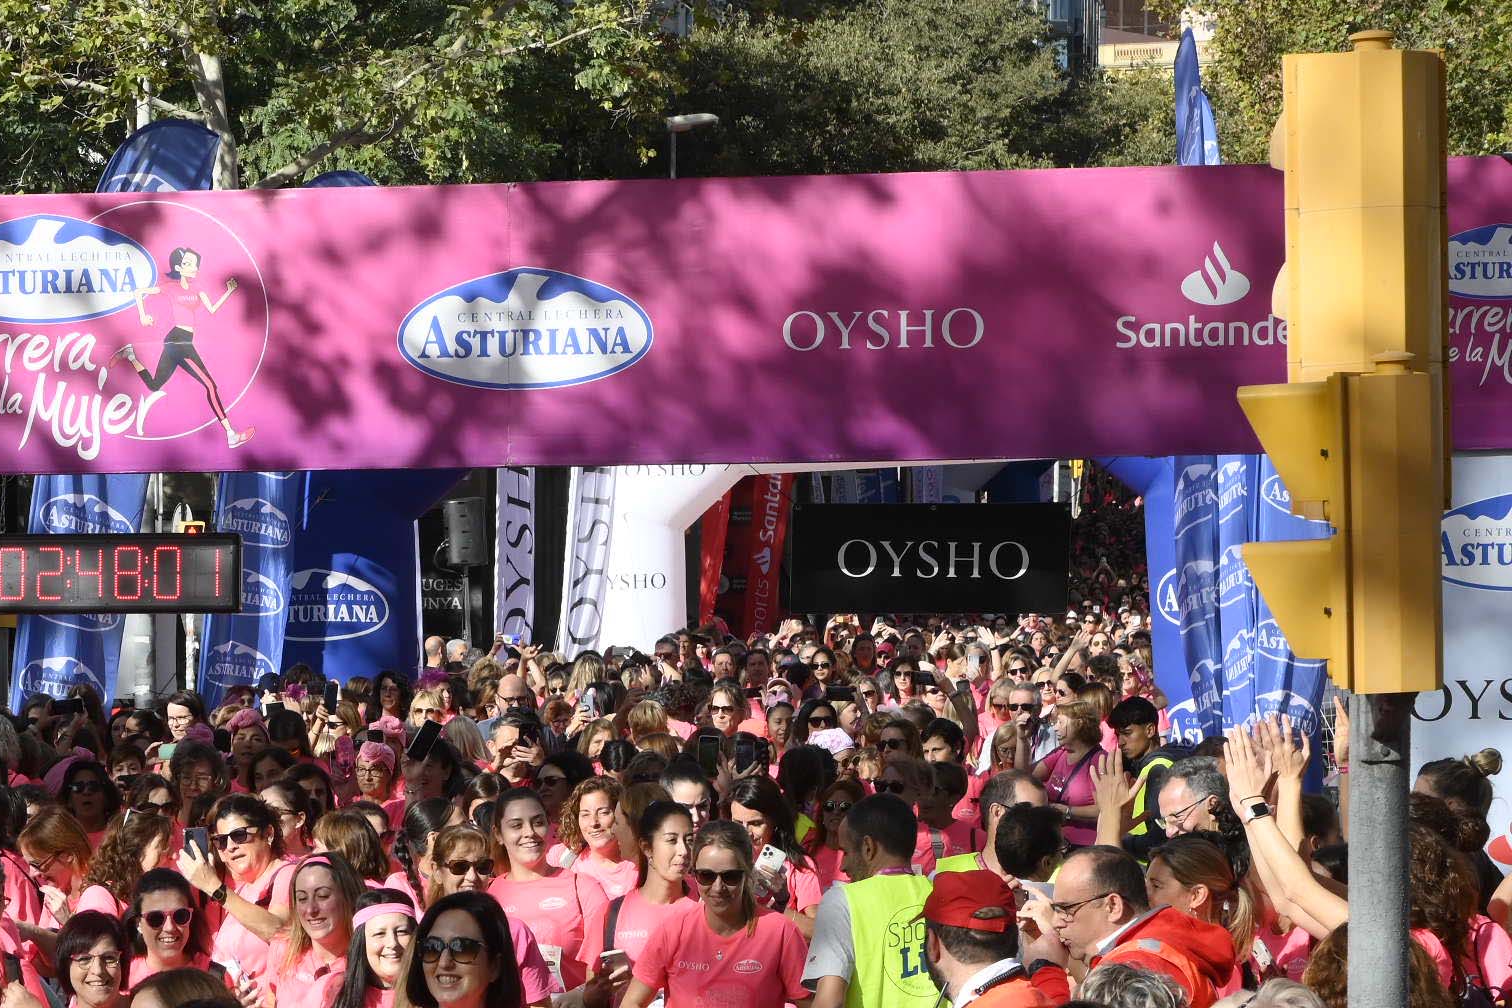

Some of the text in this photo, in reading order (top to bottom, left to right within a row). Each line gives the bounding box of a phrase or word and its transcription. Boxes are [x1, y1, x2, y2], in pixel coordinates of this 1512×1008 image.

[61, 250, 133, 262] LECHERA
[457, 308, 625, 323] CENTRAL LECHERA
[782, 306, 985, 351] OYSHO
[417, 314, 633, 359] ASTURIANA
[1115, 314, 1288, 349] Santande
[1466, 337, 1484, 363] la
[19, 368, 168, 461] Mujer
[222, 513, 289, 542] ASTURIANA
[836, 537, 1031, 581] OYSHO
[606, 572, 667, 590] YSHO
[326, 592, 375, 602] LECHERA
[288, 603, 380, 623] TURIANA
[678, 960, 710, 971] OYSHO
